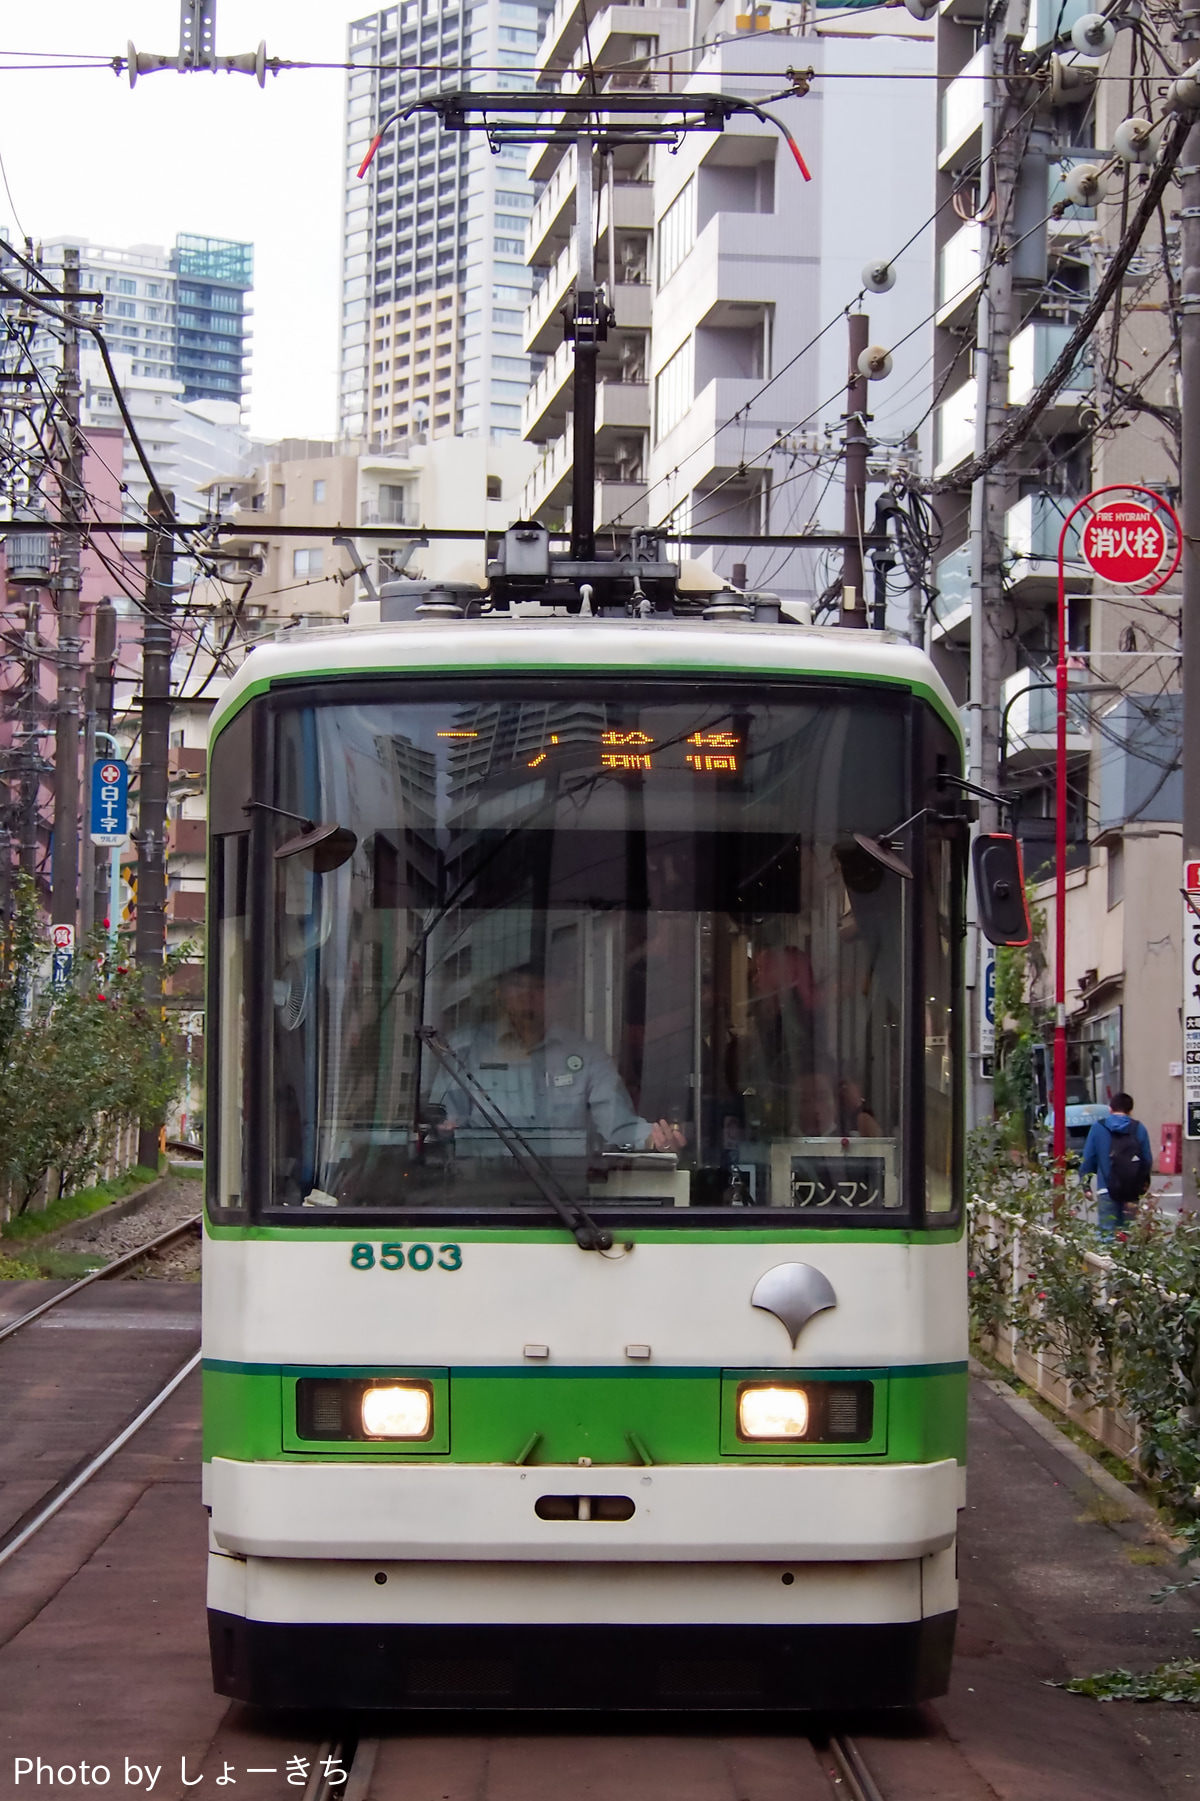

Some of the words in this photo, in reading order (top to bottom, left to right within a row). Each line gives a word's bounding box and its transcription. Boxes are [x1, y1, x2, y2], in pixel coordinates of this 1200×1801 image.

[1096, 512, 1114, 522] FIRE
[1115, 512, 1151, 522] HYDRANT
[1089, 526, 1160, 559] 消火栓
[100, 784, 119, 833] 白十字
[795, 1181, 879, 1207] ワンマン
[350, 1242, 463, 1271] 8503
